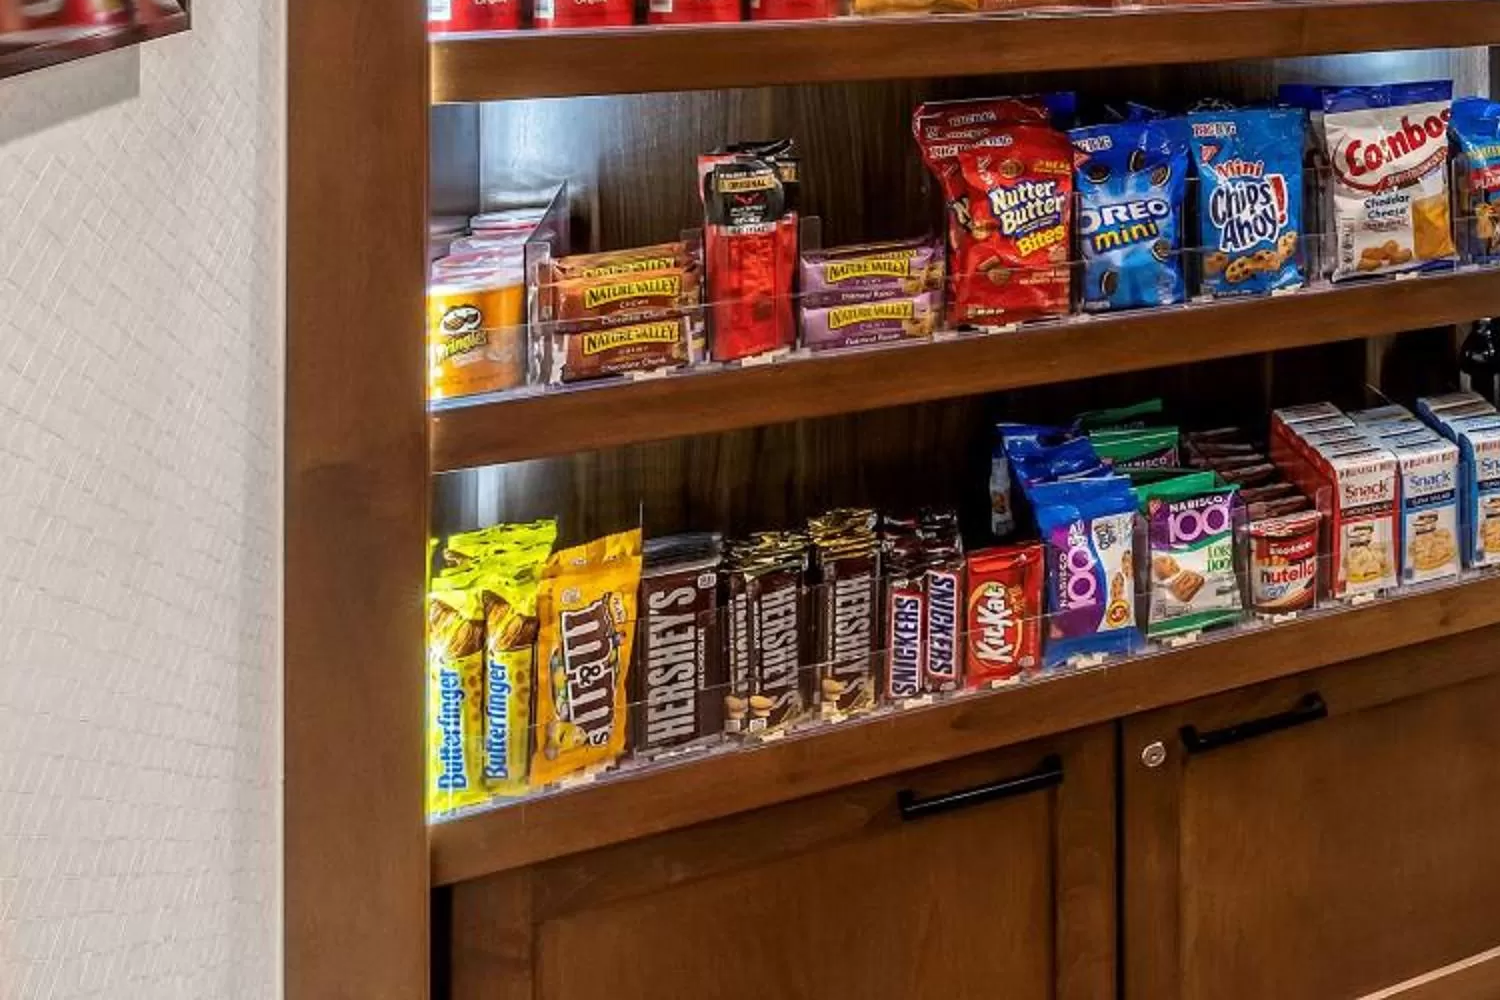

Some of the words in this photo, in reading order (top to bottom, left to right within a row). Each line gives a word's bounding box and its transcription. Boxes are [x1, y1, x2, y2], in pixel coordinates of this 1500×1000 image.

[990, 180, 1056, 214] Nutter
[1211, 182, 1271, 226] Chips
[1364, 193, 1410, 208] Cheddar
[1000, 196, 1065, 233] Butter
[1080, 199, 1169, 234] OREO
[1015, 225, 1067, 257] Bites
[1093, 220, 1158, 251] mini
[829, 263, 871, 281] NATURE
[588, 284, 633, 303] NATURE
[634, 277, 678, 295] VALLEY
[830, 308, 873, 327] NATURE
[875, 304, 911, 319] VALLEY
[586, 331, 632, 351] NATURE
[634, 323, 678, 342] VALLEY
[1345, 480, 1389, 498] Snack
[1409, 471, 1451, 487] Snack
[1169, 495, 1224, 513] NABISCO
[1168, 504, 1230, 543] 100
[1067, 546, 1096, 609] 100
[1261, 556, 1315, 584] nutella
[928, 572, 956, 675] SNICKERS
[892, 596, 920, 697] SNICKERS
[437, 667, 467, 790] Butterfinger
[485, 659, 512, 780] Butterfinger
